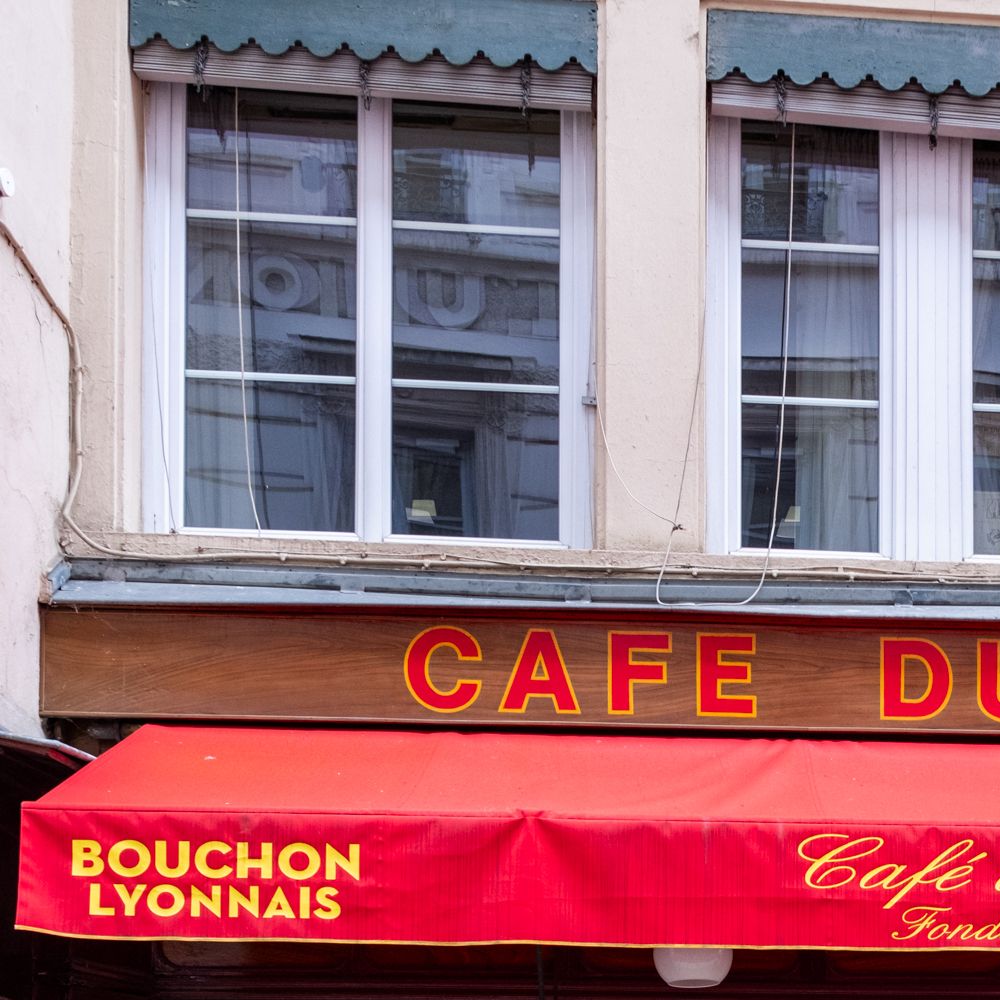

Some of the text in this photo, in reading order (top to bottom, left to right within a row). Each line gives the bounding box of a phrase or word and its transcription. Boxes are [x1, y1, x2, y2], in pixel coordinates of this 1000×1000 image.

[403, 626, 758, 718] CAFE
[71, 838, 361, 881] BOUCHON
[797, 833, 988, 909] Café
[88, 883, 342, 920] LYONNAIS
